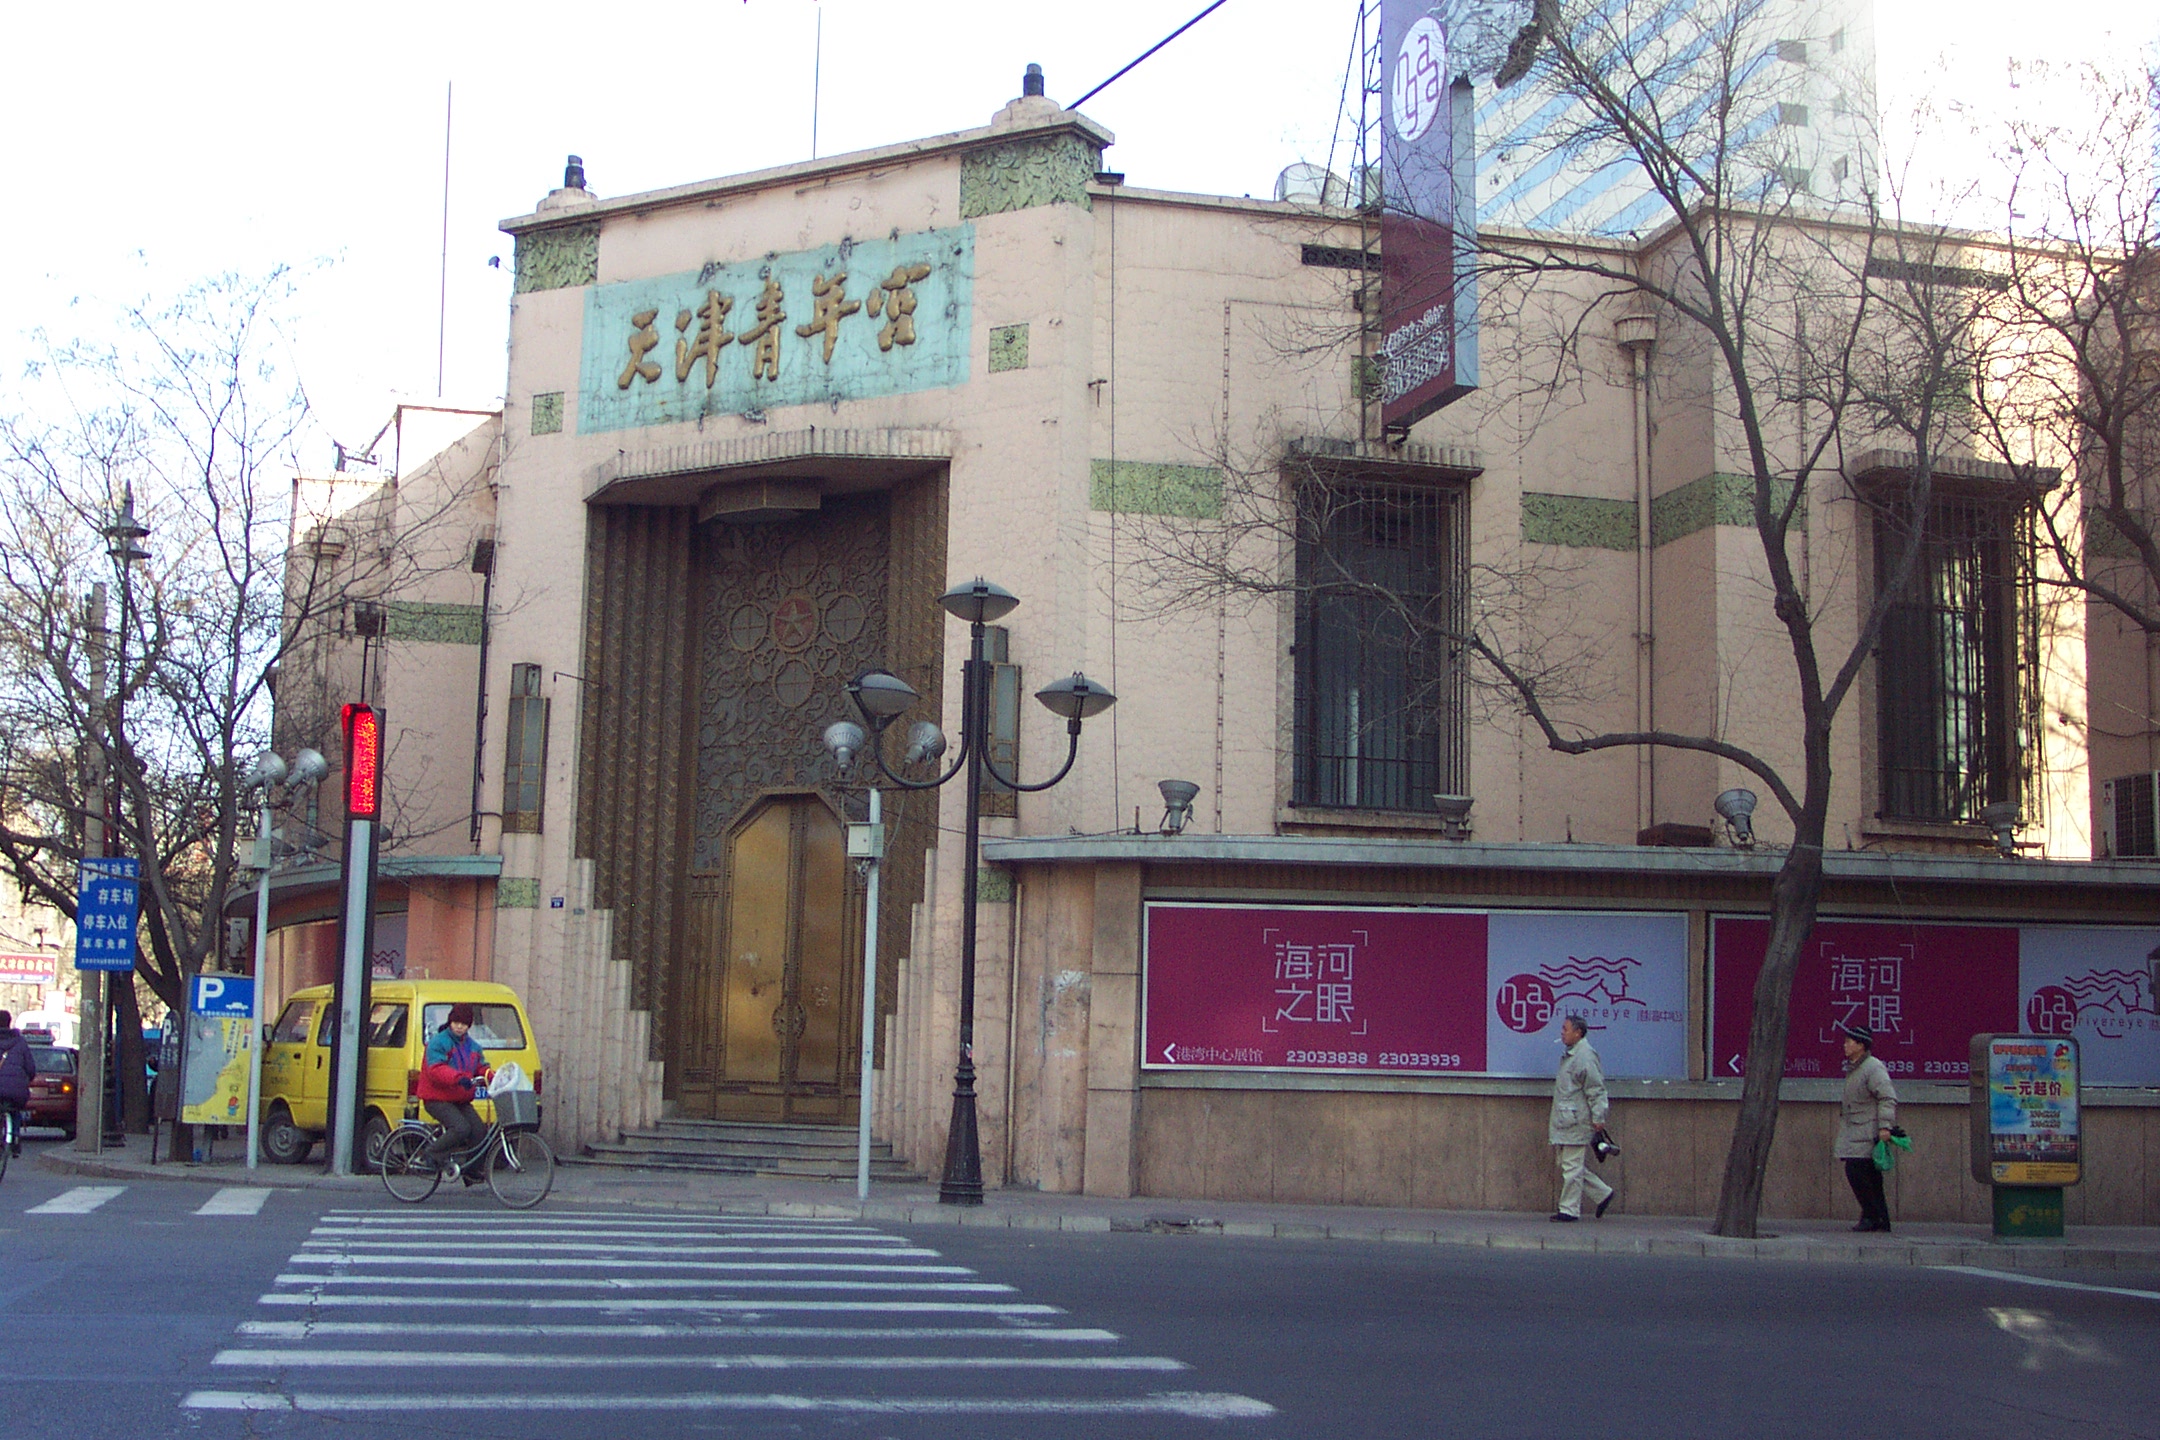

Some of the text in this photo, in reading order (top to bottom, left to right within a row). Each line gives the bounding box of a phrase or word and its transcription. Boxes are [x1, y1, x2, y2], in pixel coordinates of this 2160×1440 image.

[617, 262, 932, 390] 天津青年宫
[81, 862, 98, 892] P
[98, 888, 134, 905] 存车场
[83, 914, 128, 930] 停车入位
[1274, 940, 1356, 981] 海河
[1831, 955, 1903, 993] 海河
[198, 977, 225, 1010] P
[1274, 982, 1355, 1025] 之眼
[1555, 1004, 1631, 1022] rivereye
[1831, 994, 1903, 1033] 之眼
[2078, 1016, 2144, 1029] rivereye
[162, 1018, 172, 1045] P
[1176, 1046, 1264, 1063] 港湾中心展馆
[1286, 1049, 1461, 1067] 23033838 23033939
[2003, 1080, 2062, 1097] 一元起价
